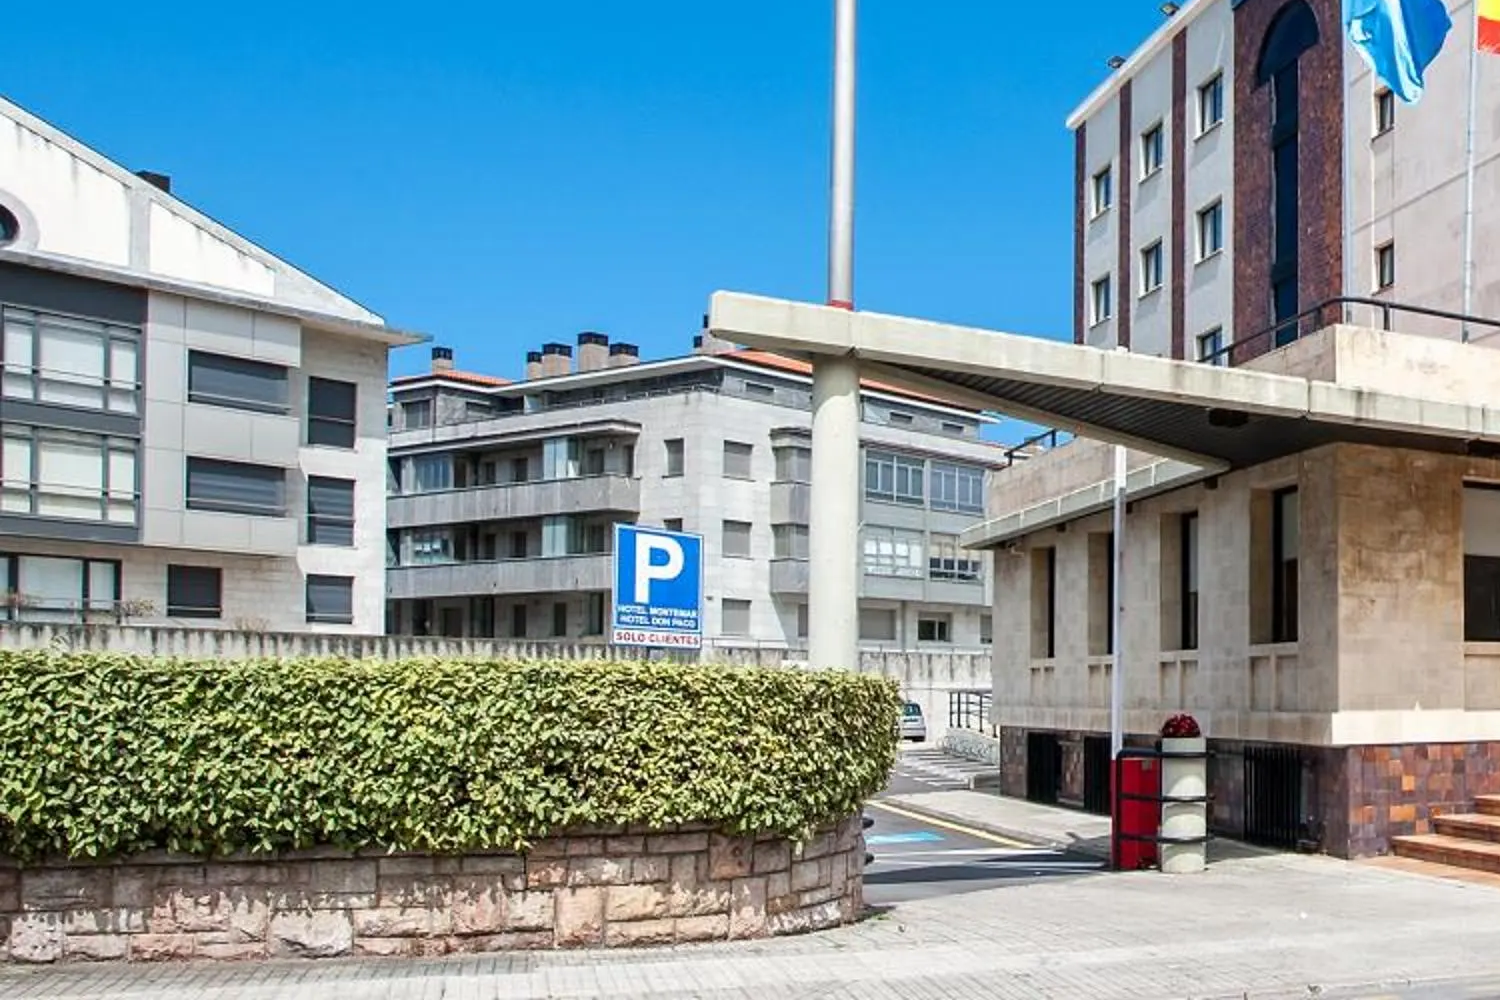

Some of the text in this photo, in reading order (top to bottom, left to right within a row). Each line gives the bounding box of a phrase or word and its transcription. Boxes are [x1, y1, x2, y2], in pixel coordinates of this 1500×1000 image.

[634, 532, 685, 604] P
[618, 604, 698, 617] HOTEL MONTEMAR
[619, 614, 650, 625] HOTEL
[652, 616, 671, 627] DON
[616, 631, 699, 645] SOLO CLIENTES
